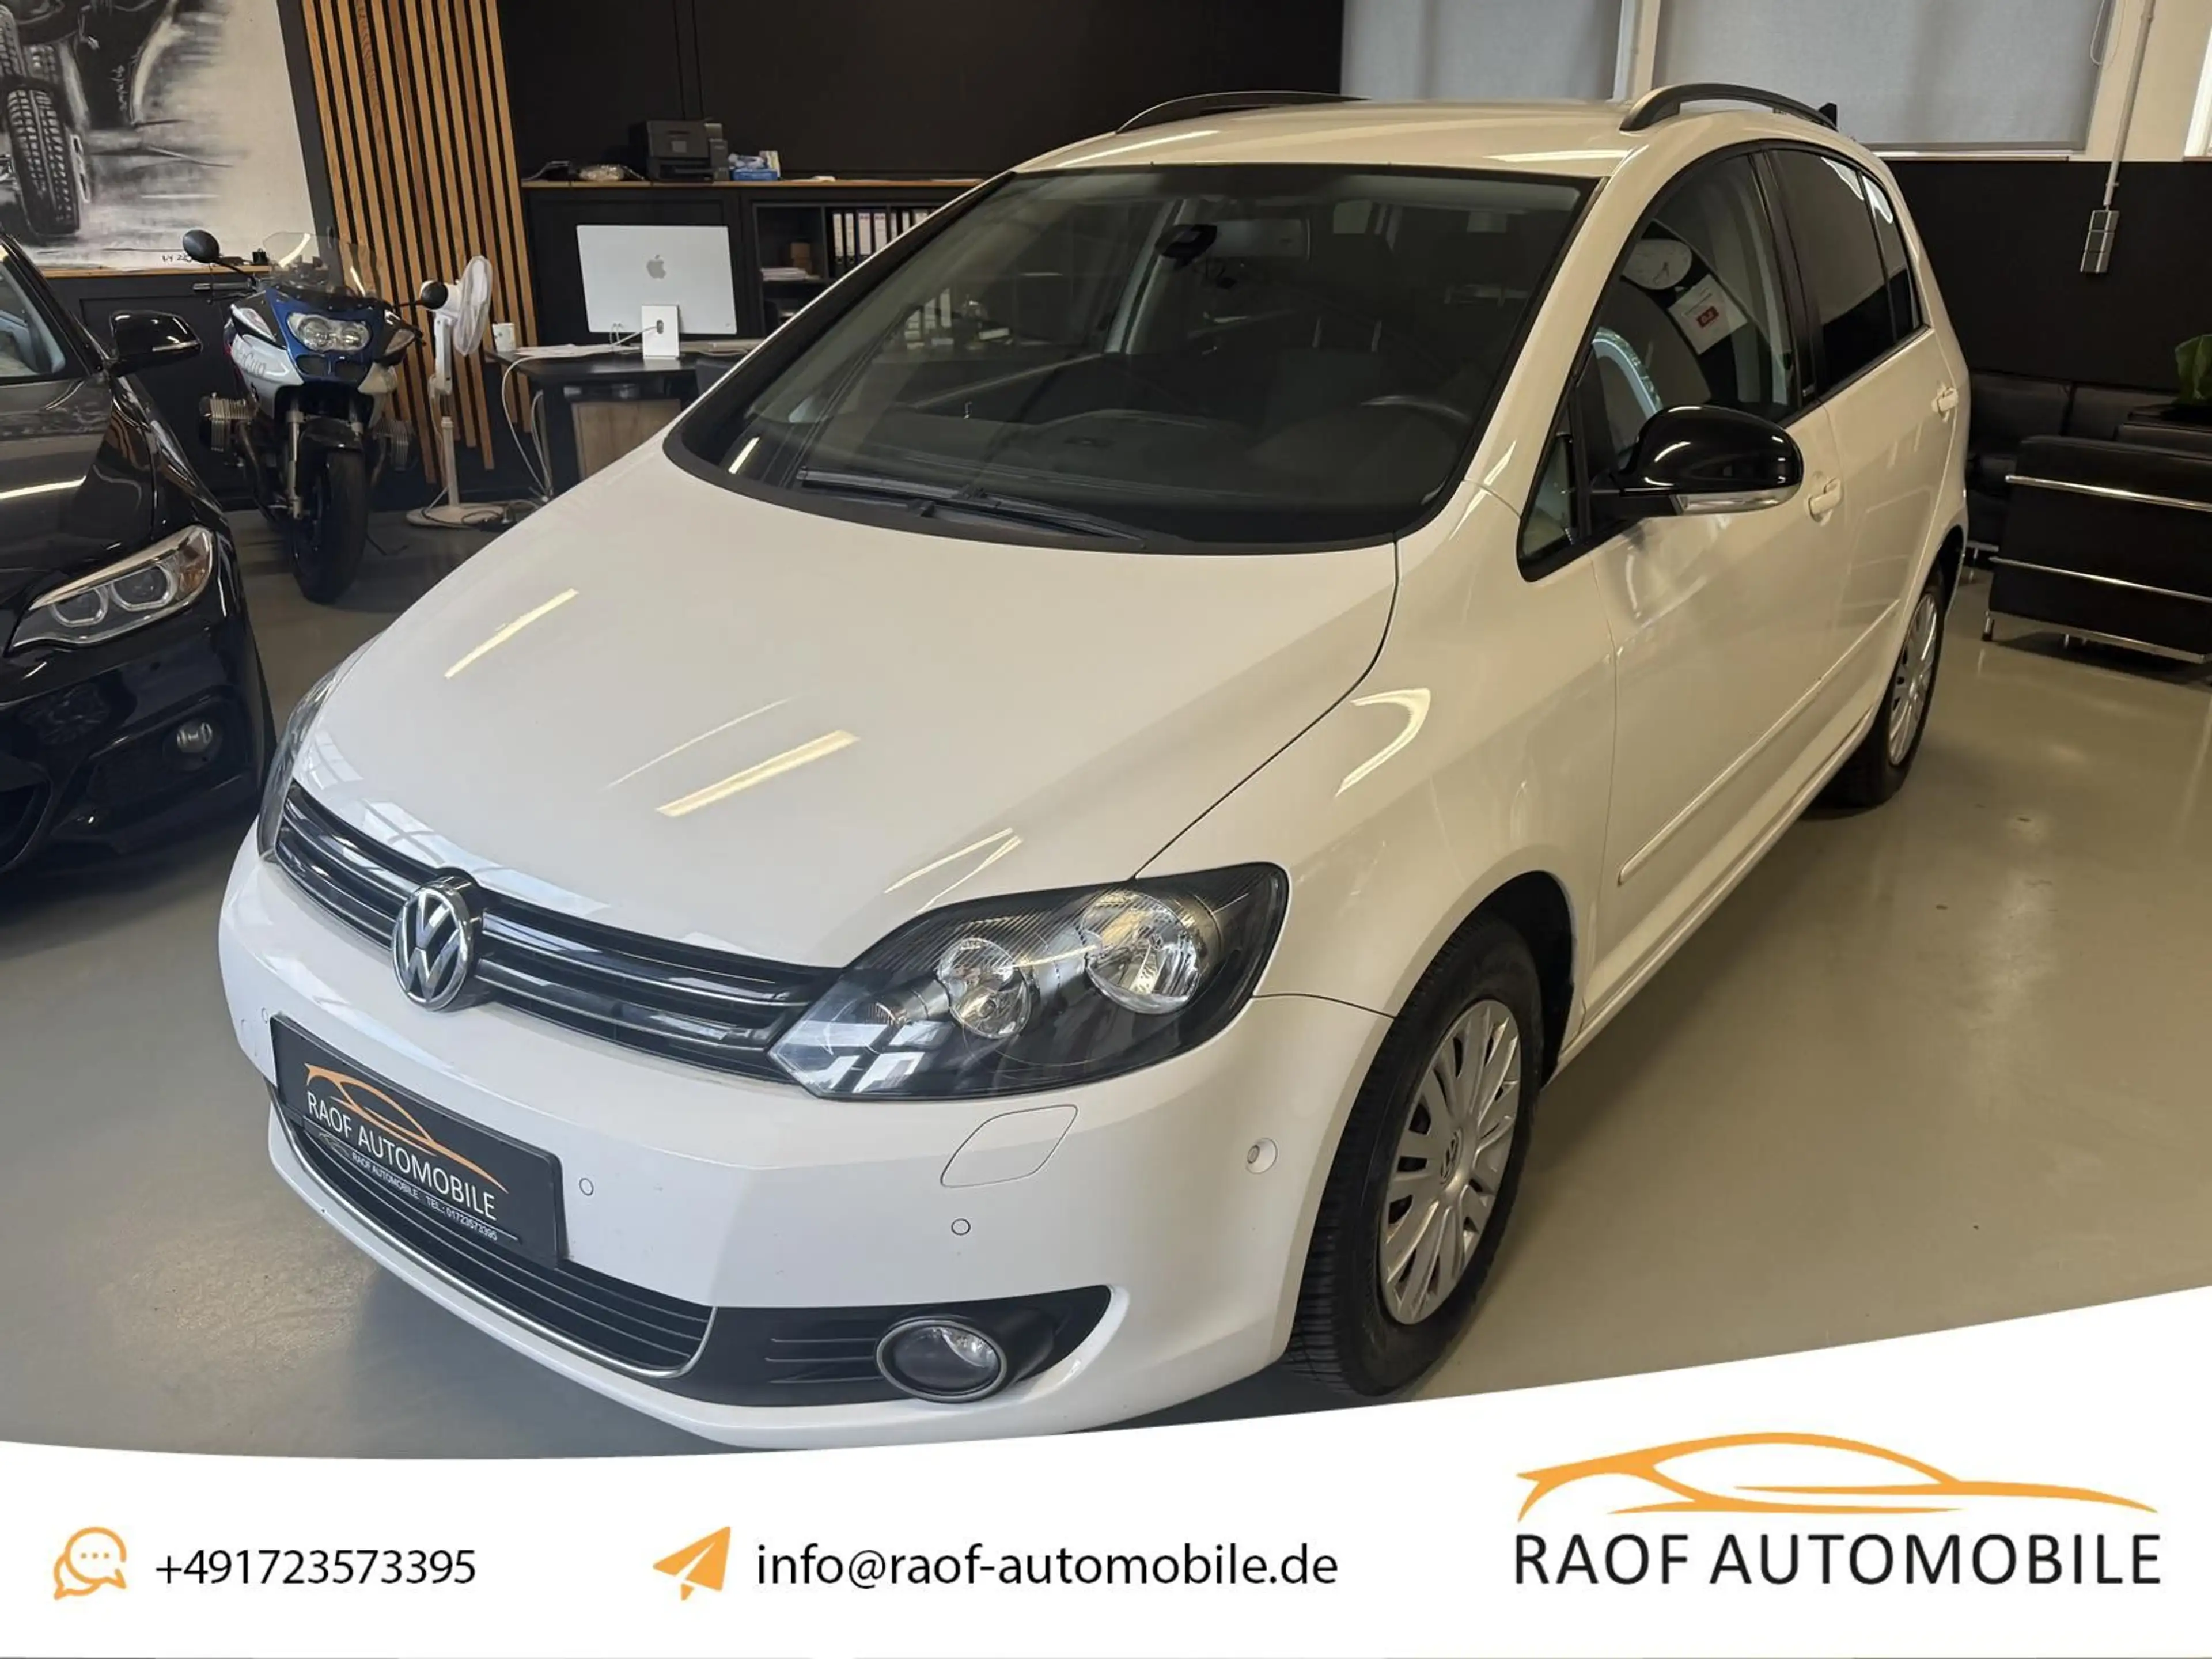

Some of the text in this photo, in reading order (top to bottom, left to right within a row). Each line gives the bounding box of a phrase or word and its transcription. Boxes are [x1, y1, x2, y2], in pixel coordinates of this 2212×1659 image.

[307, 1091, 497, 1221] RAOF AUTOMOBILE
[352, 1152, 371, 1169] RAOF
[371, 1162, 420, 1200] AUTOMOBILE
